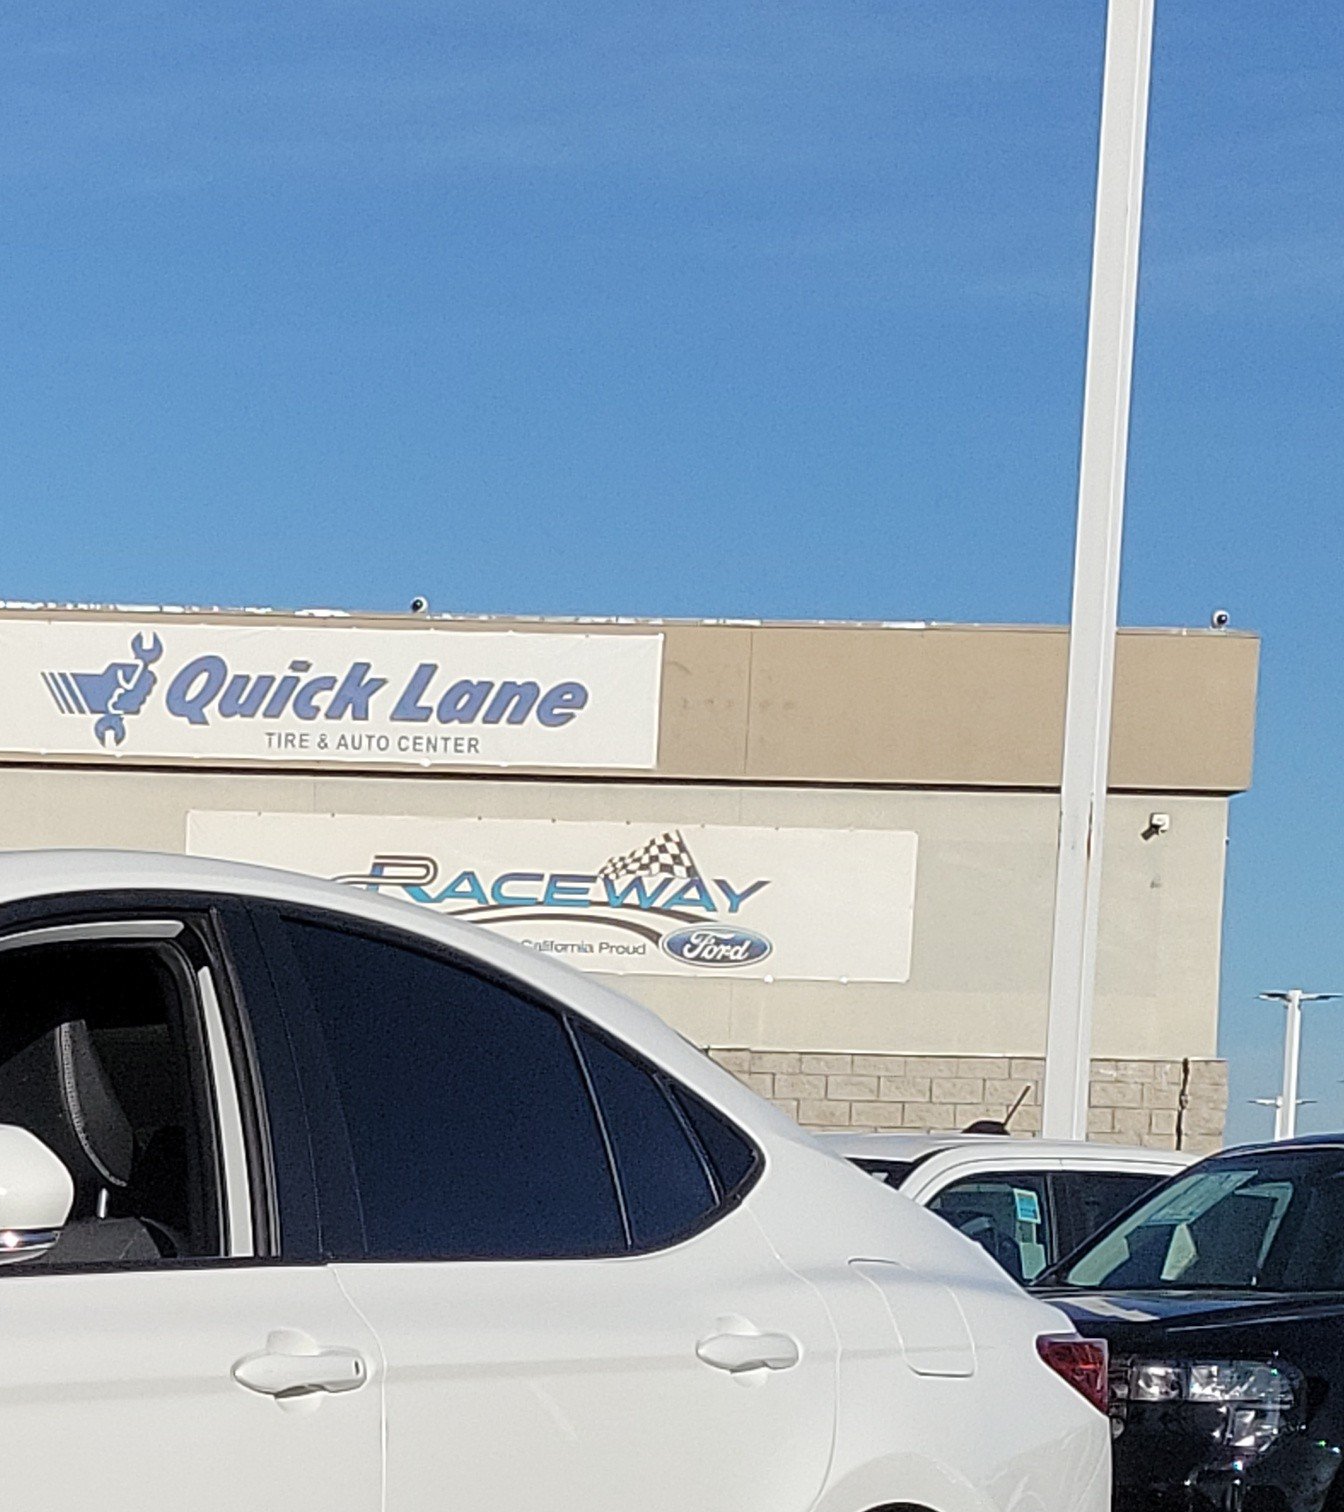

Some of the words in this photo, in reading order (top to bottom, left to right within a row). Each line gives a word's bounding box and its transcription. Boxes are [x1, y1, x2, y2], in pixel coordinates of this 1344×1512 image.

[166, 655, 388, 725] Quick
[390, 663, 589, 728] Lane
[265, 732, 310, 749] TIRE
[317, 734, 329, 750] &
[336, 734, 391, 751] AUTO
[398, 736, 480, 753] CENTER
[366, 855, 771, 913] RACEWAY
[599, 942, 646, 955] Proud
[683, 932, 750, 962] Ford
